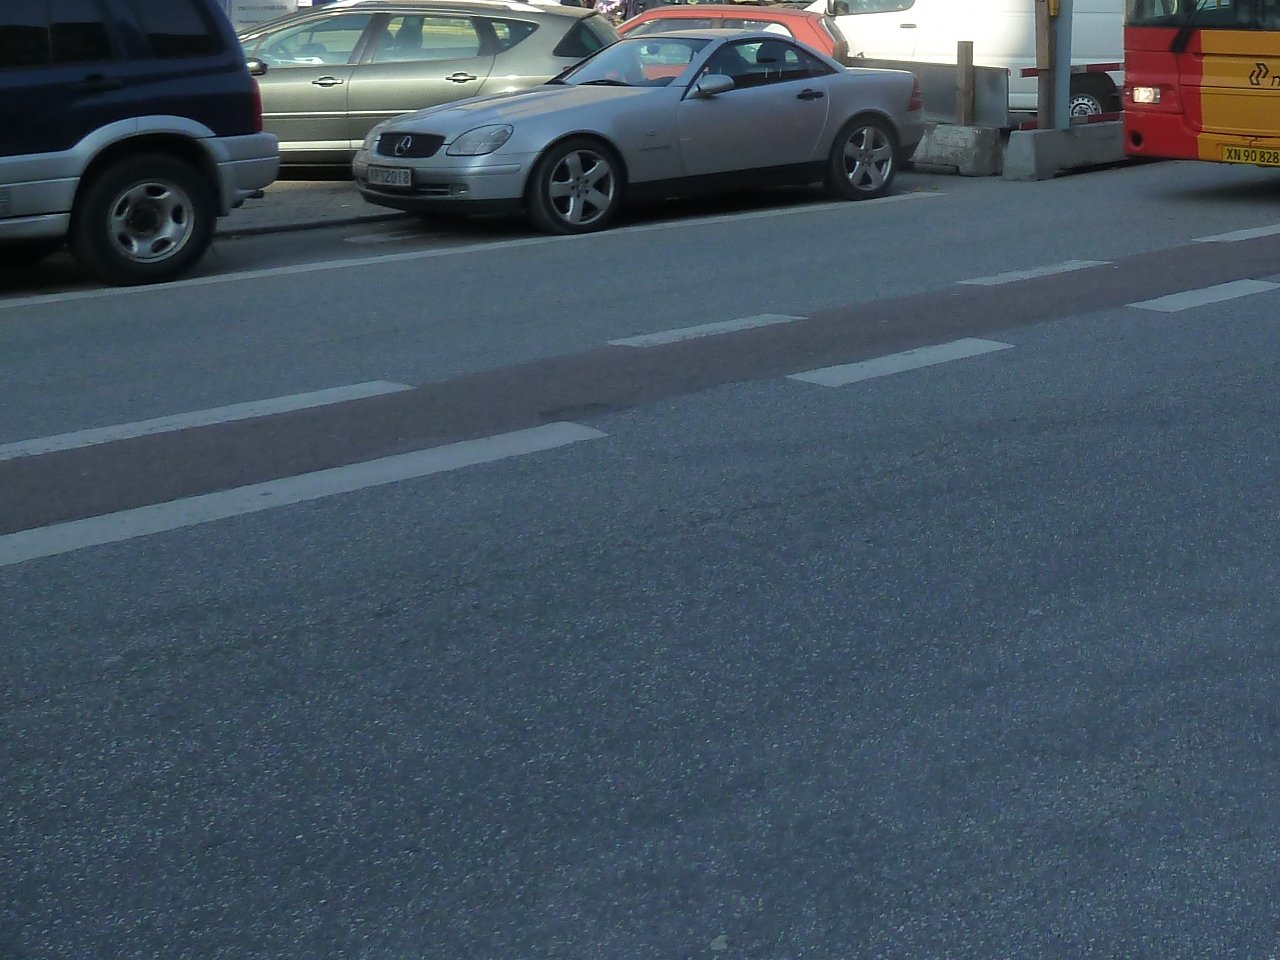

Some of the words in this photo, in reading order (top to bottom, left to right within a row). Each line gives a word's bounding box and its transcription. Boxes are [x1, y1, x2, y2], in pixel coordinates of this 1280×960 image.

[1226, 148, 1241, 160] XN
[1243, 149, 1257, 162] 90
[1259, 150, 1280, 163] 828
